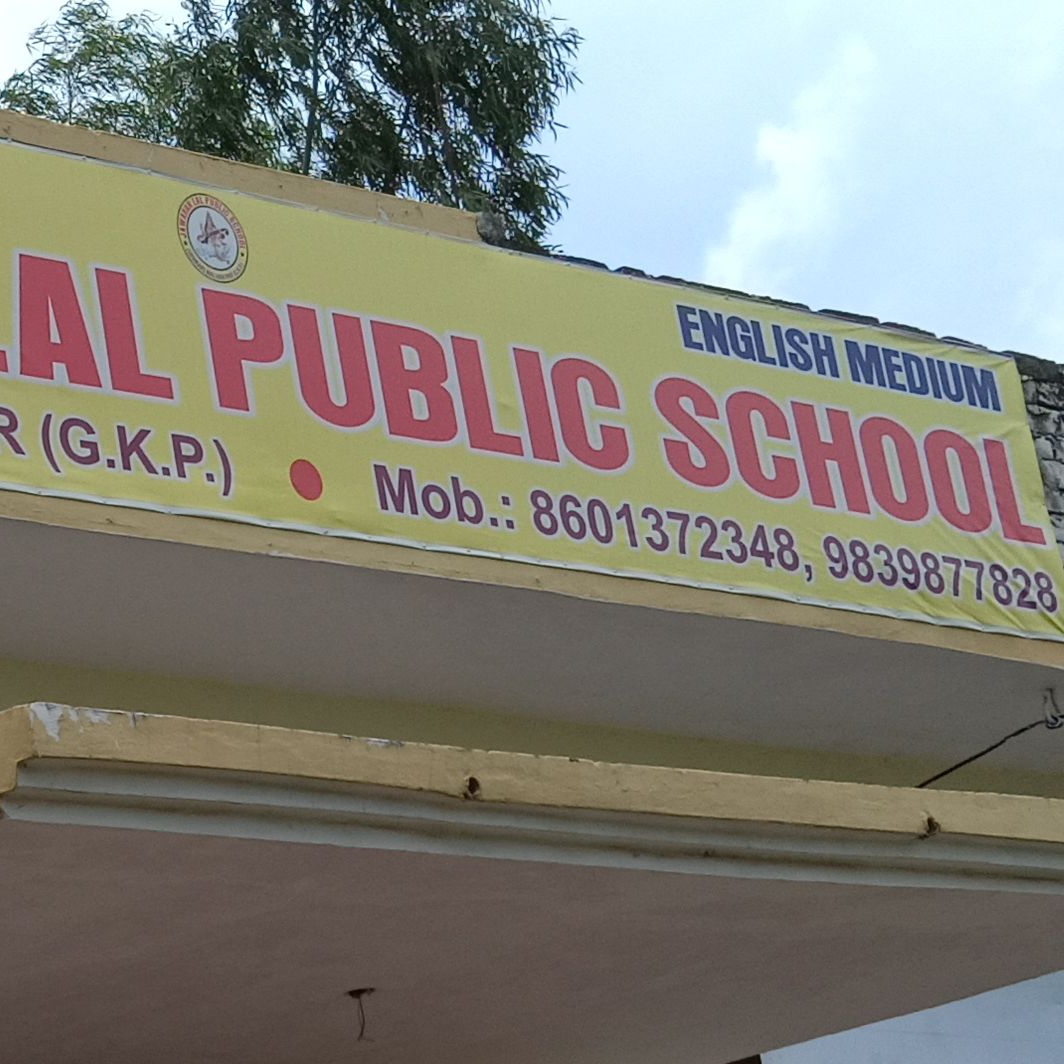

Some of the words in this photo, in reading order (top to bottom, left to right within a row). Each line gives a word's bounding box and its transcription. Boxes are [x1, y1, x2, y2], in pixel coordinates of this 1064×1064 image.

[201, 287, 630, 471] PUBLIC
[654, 377, 1046, 545] SCHOOL
[676, 304, 840, 379] ENGLISH
[844, 338, 1002, 412] MEDIUM
[41, 413, 233, 497] (G.K.P.)
[374, 464, 516, 530] Mob.:
[530, 489, 813, 582] 8601372348,
[822, 535, 1058, 613] 9839877828
